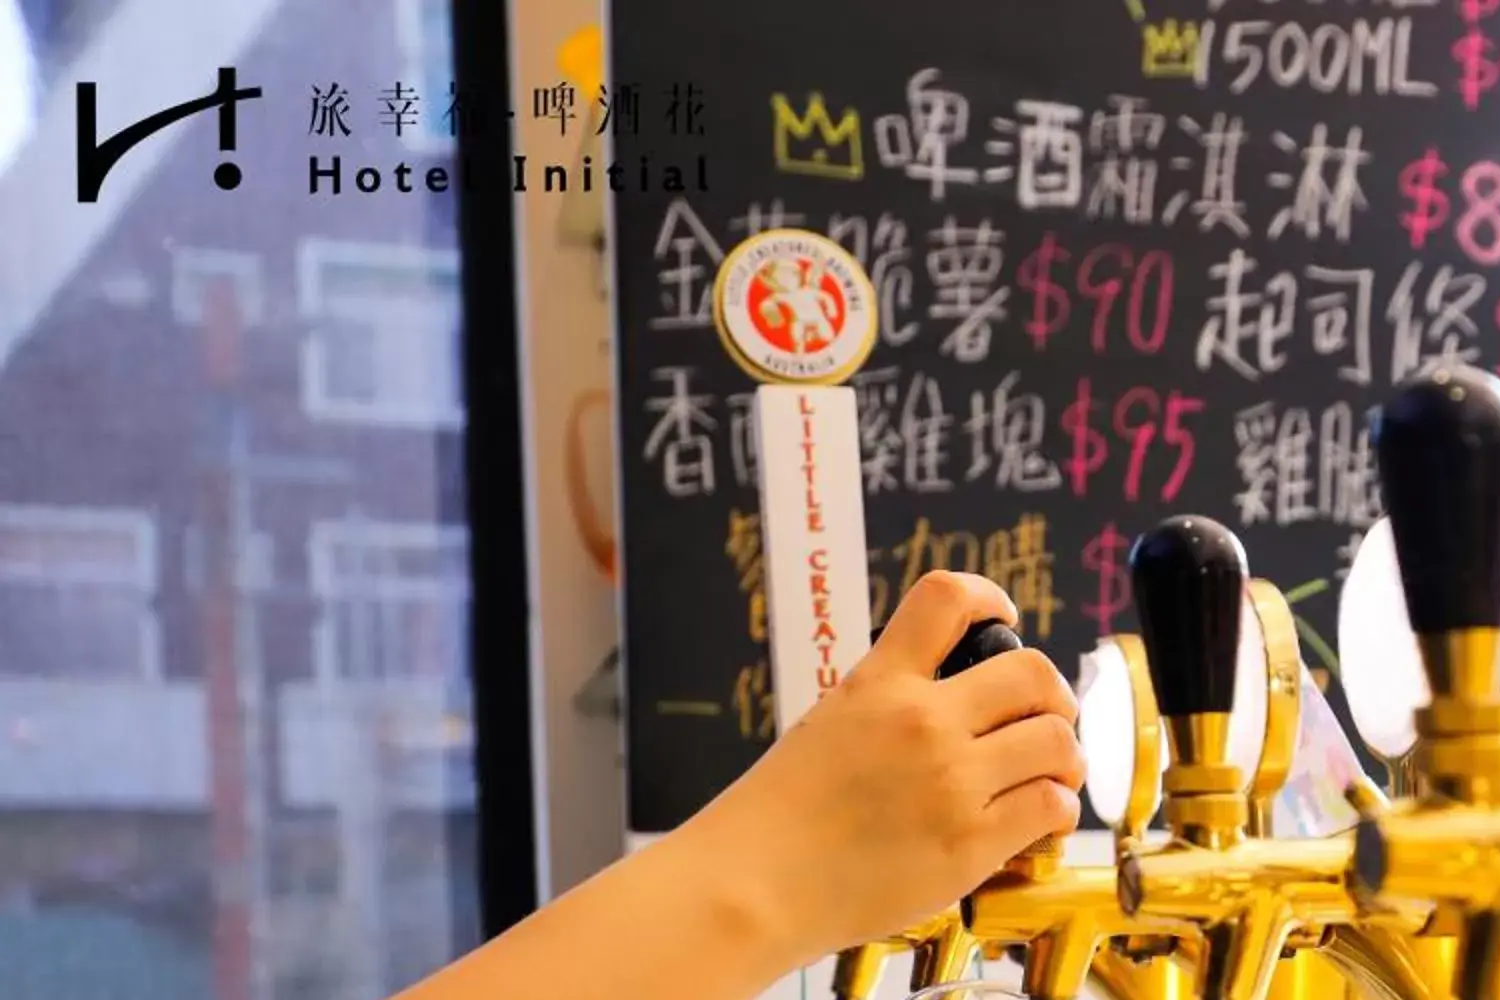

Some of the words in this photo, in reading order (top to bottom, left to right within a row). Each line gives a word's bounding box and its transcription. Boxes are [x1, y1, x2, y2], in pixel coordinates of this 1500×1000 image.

[1192, 16, 1440, 97] 1500ML
[651, 198, 1011, 362] 金脆薯
[1015, 229, 1175, 354] $90
[797, 393, 825, 534] LITTLE
[1061, 376, 1206, 503] $95
[808, 549, 838, 699] CREATU
